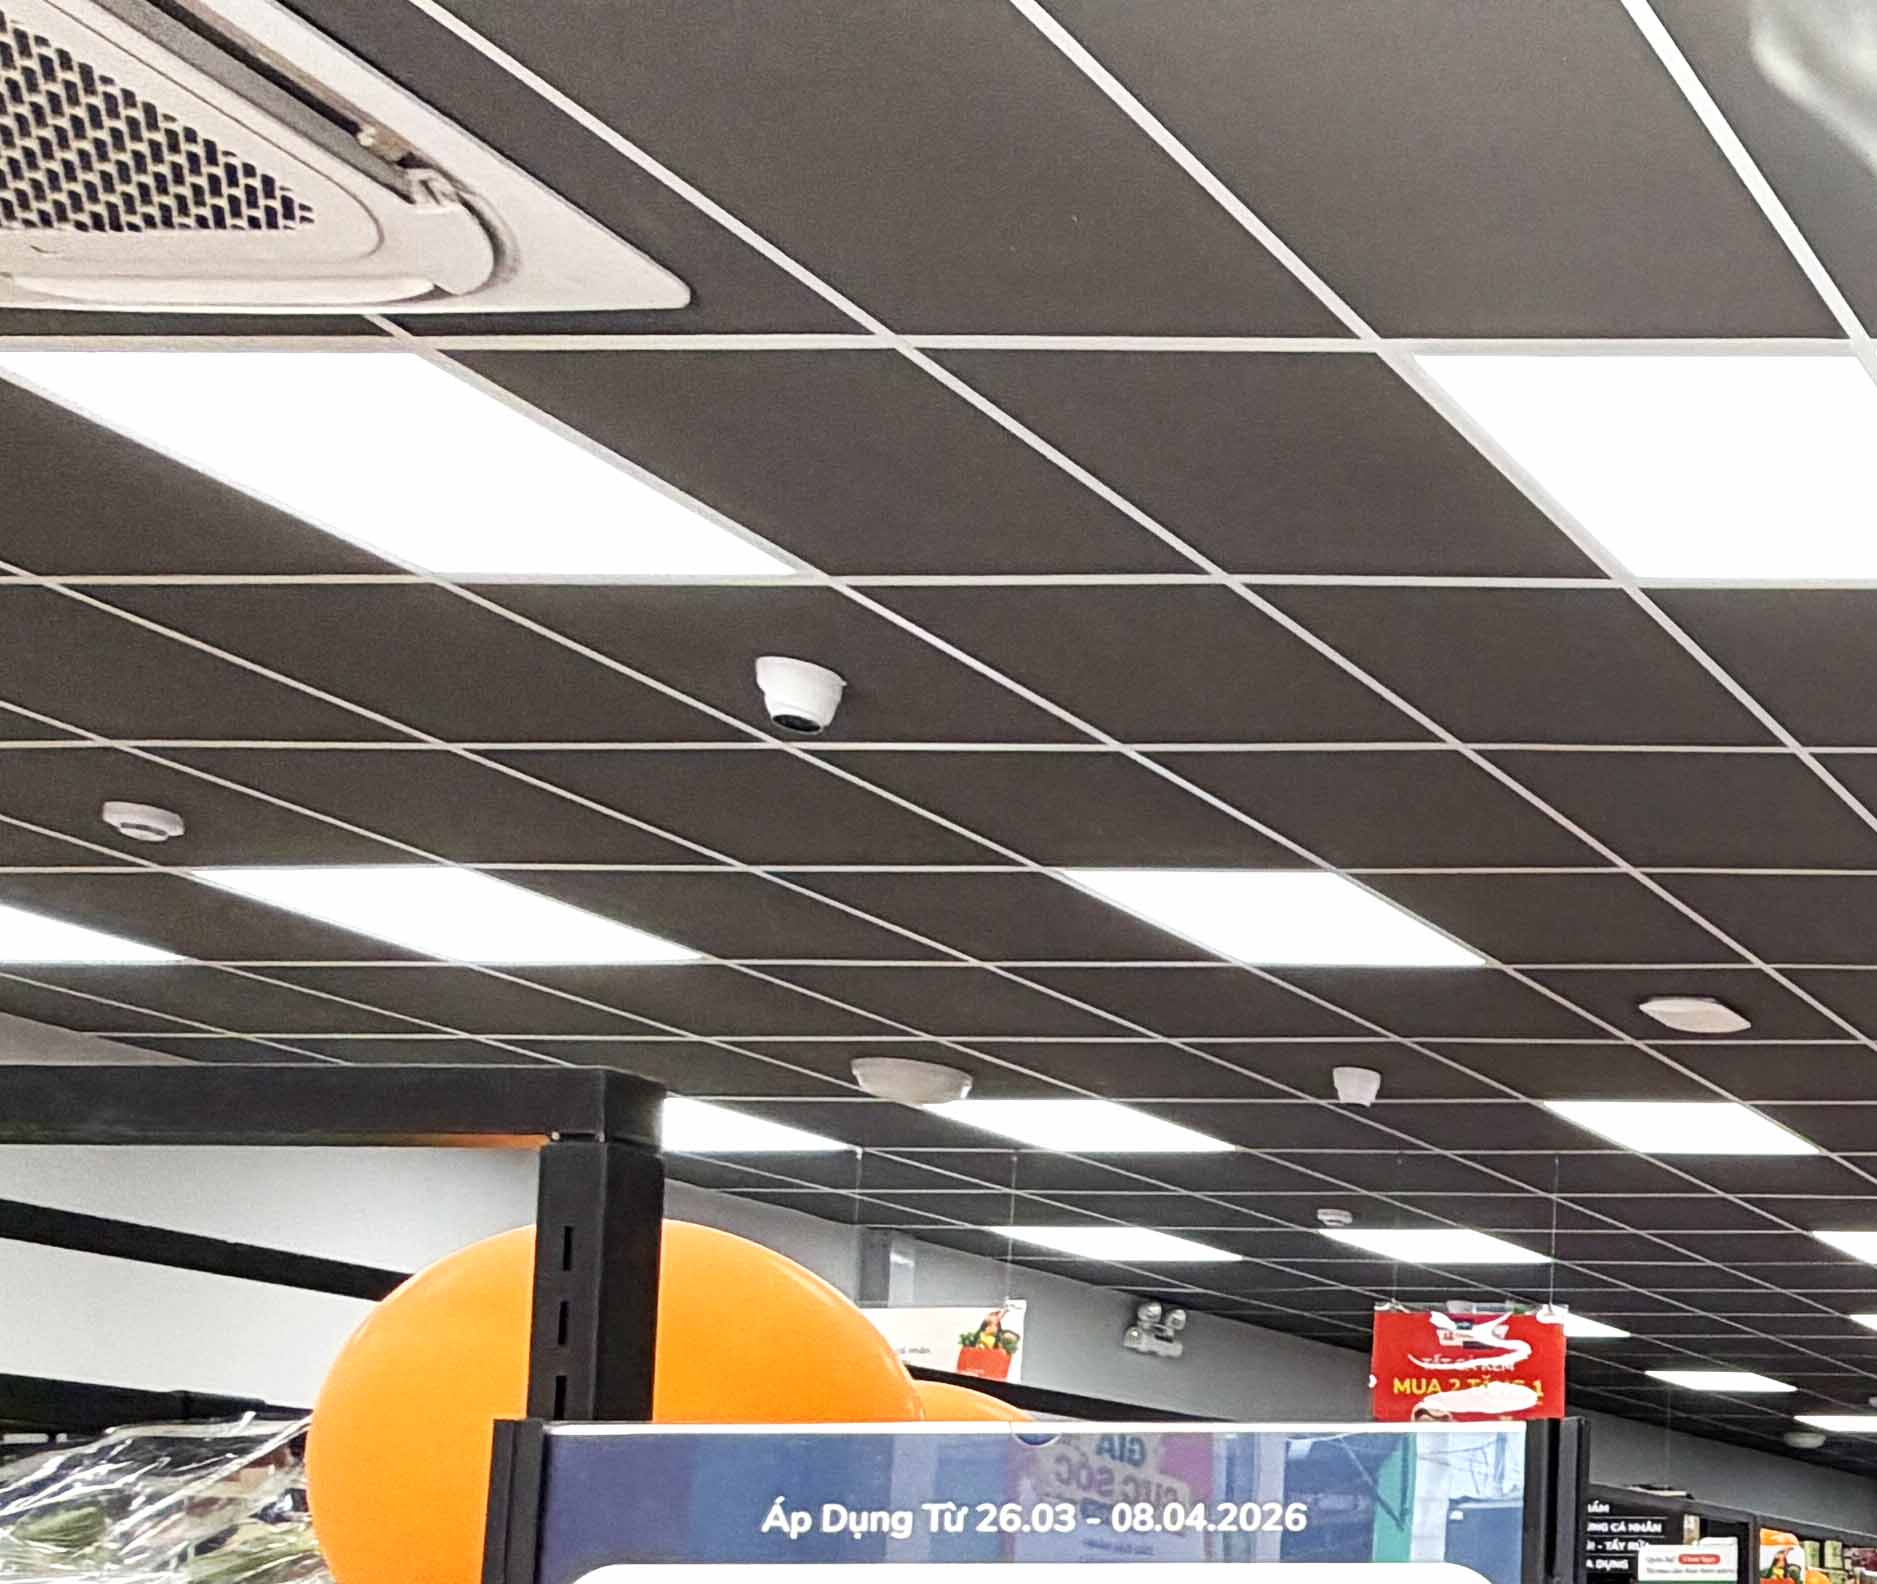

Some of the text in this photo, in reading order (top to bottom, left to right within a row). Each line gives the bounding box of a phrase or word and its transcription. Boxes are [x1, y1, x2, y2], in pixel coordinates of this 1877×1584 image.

[1392, 1376, 1442, 1396] MUA
[761, 1500, 813, 1538] Áp
[820, 1500, 915, 1542] Dụng
[920, 1495, 969, 1534] Từ
[976, 1502, 1077, 1533] 26.03
[1111, 1502, 1309, 1533] 08.04.2026
